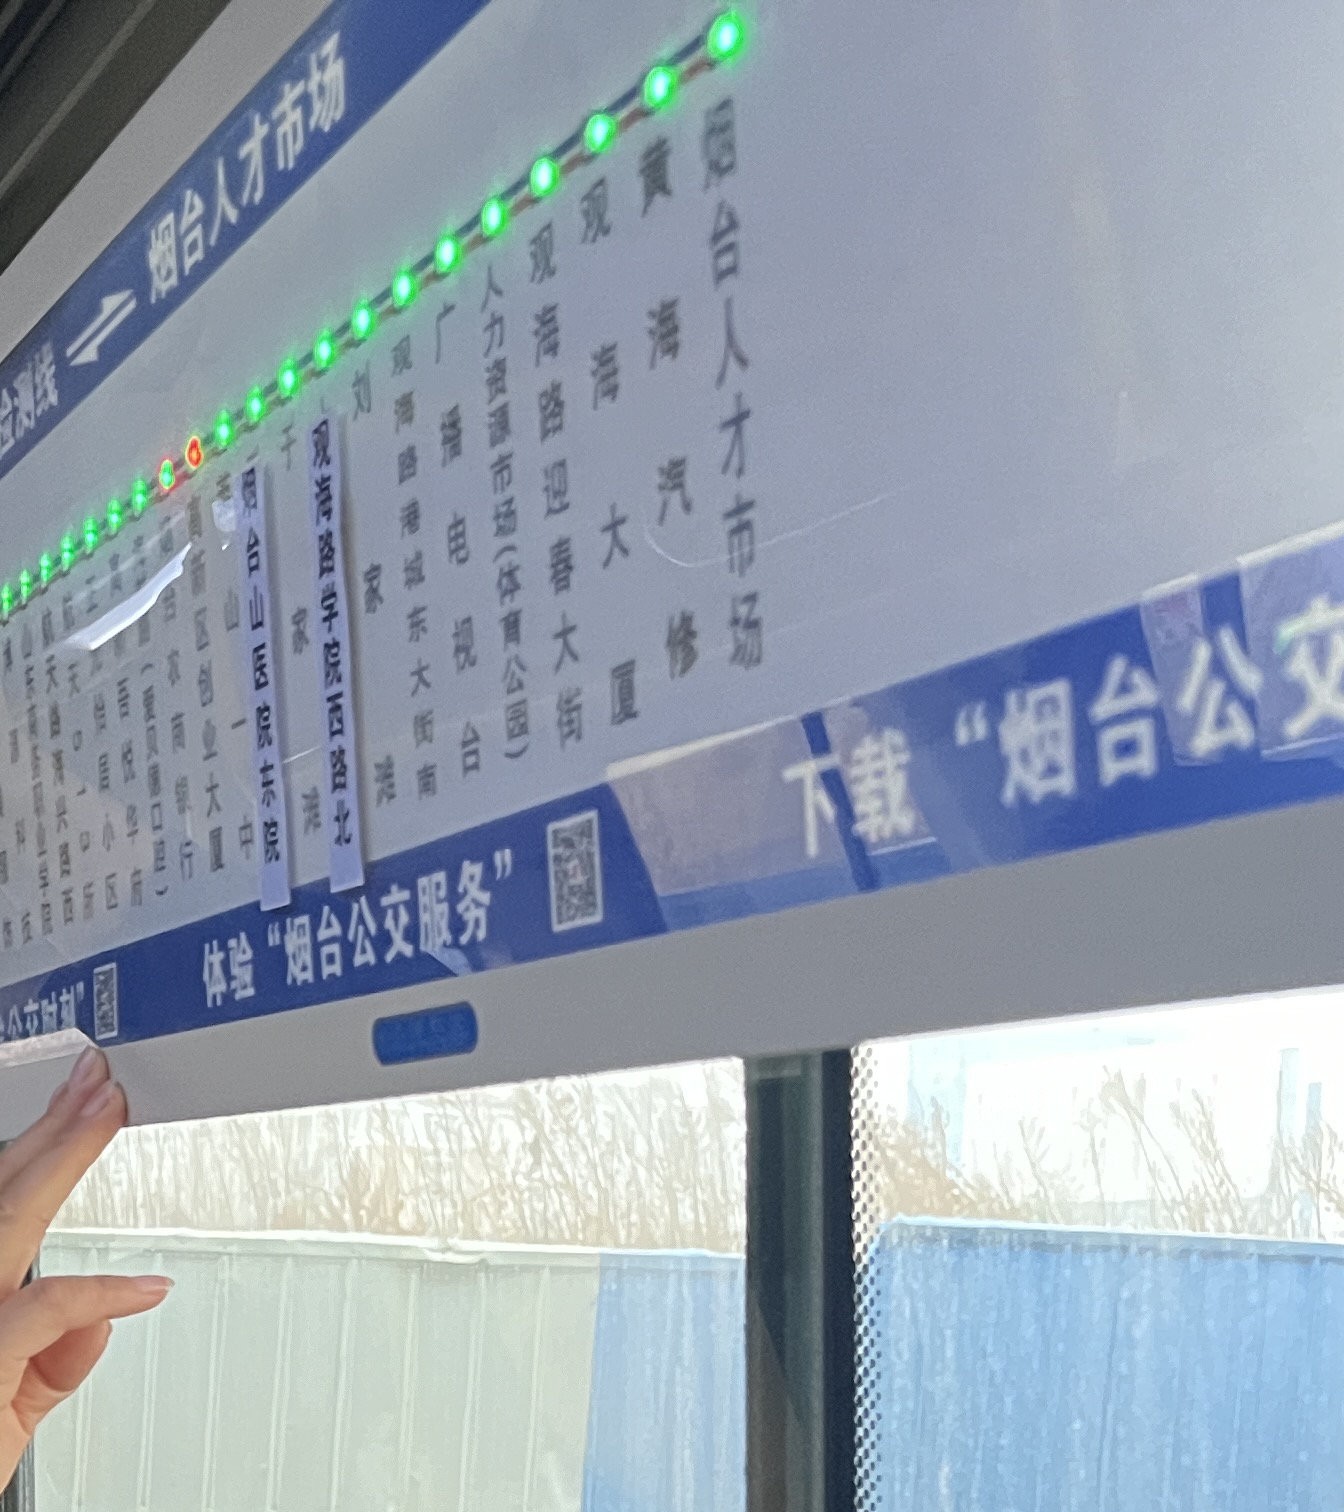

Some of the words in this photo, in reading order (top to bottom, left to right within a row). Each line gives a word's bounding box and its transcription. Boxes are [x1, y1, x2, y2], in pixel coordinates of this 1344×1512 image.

[146, 31, 347, 304] 烟台人才市场
[699, 97, 764, 670] 烟台人才市场
[434, 301, 482, 778] 广播电视台
[578, 177, 639, 727] 观海大厦
[638, 136, 699, 680] 黄海汽修
[202, 923, 254, 1008] 体验
[783, 727, 914, 859] 下载
